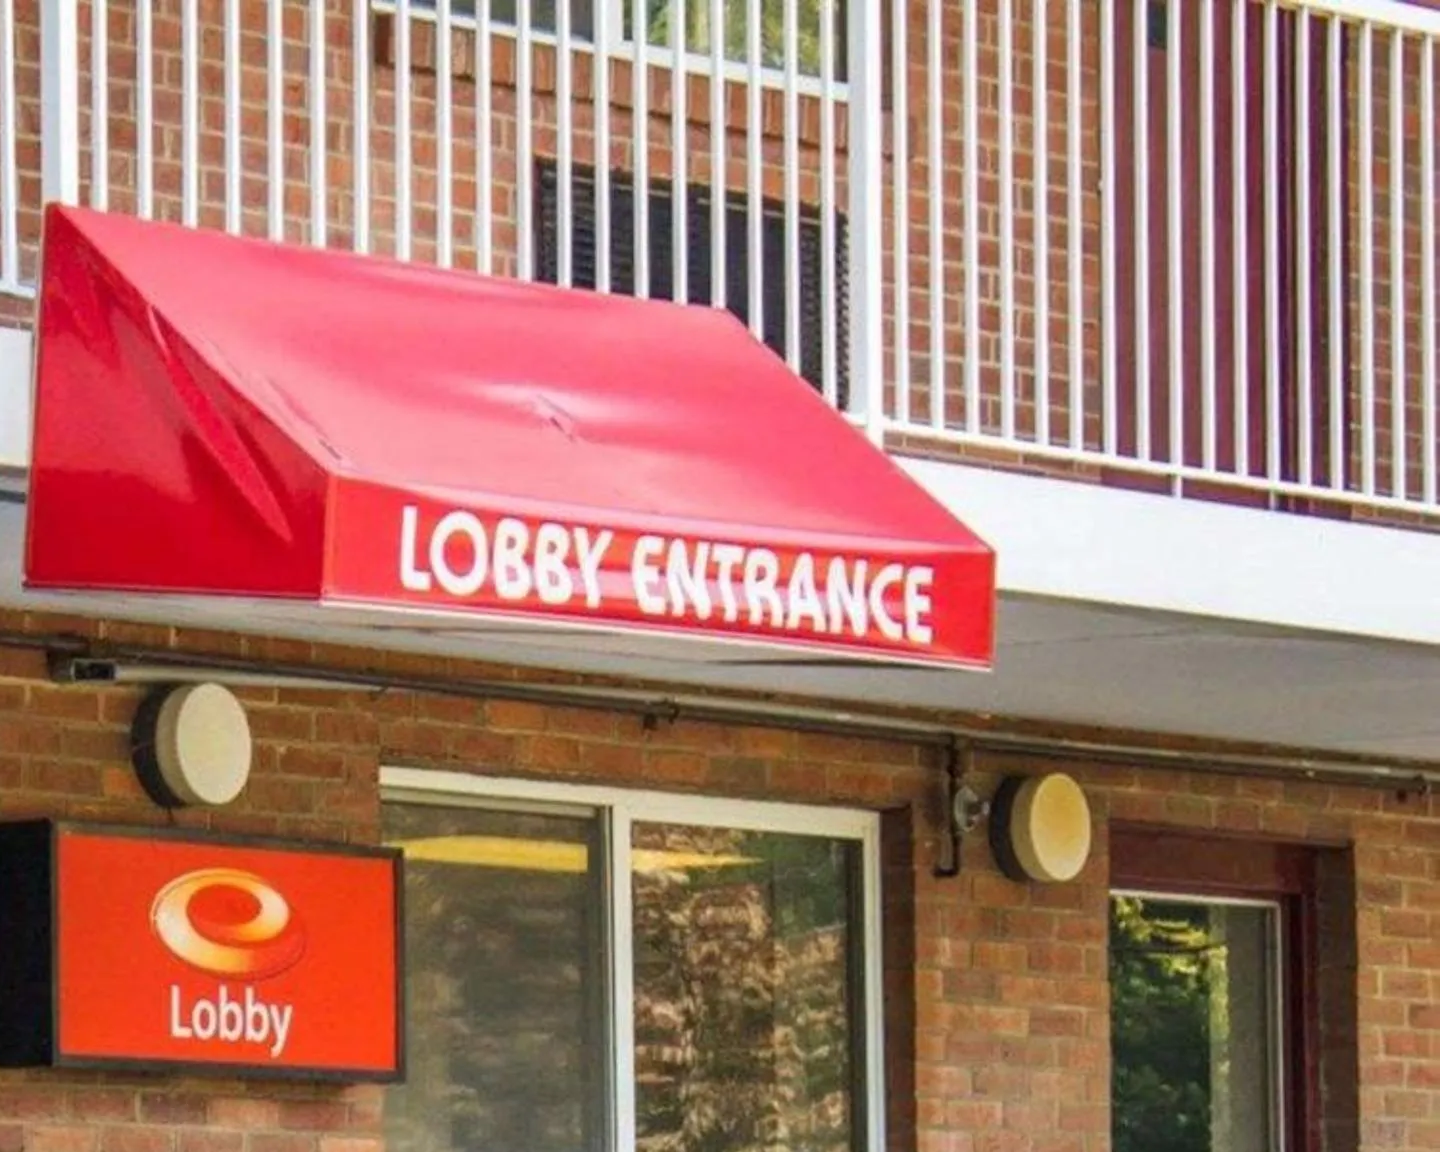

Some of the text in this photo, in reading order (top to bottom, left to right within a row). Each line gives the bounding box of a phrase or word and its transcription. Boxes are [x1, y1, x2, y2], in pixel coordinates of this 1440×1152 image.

[400, 505, 934, 644] LOBBY ENTRANCE
[171, 985, 293, 1058] Lobby
